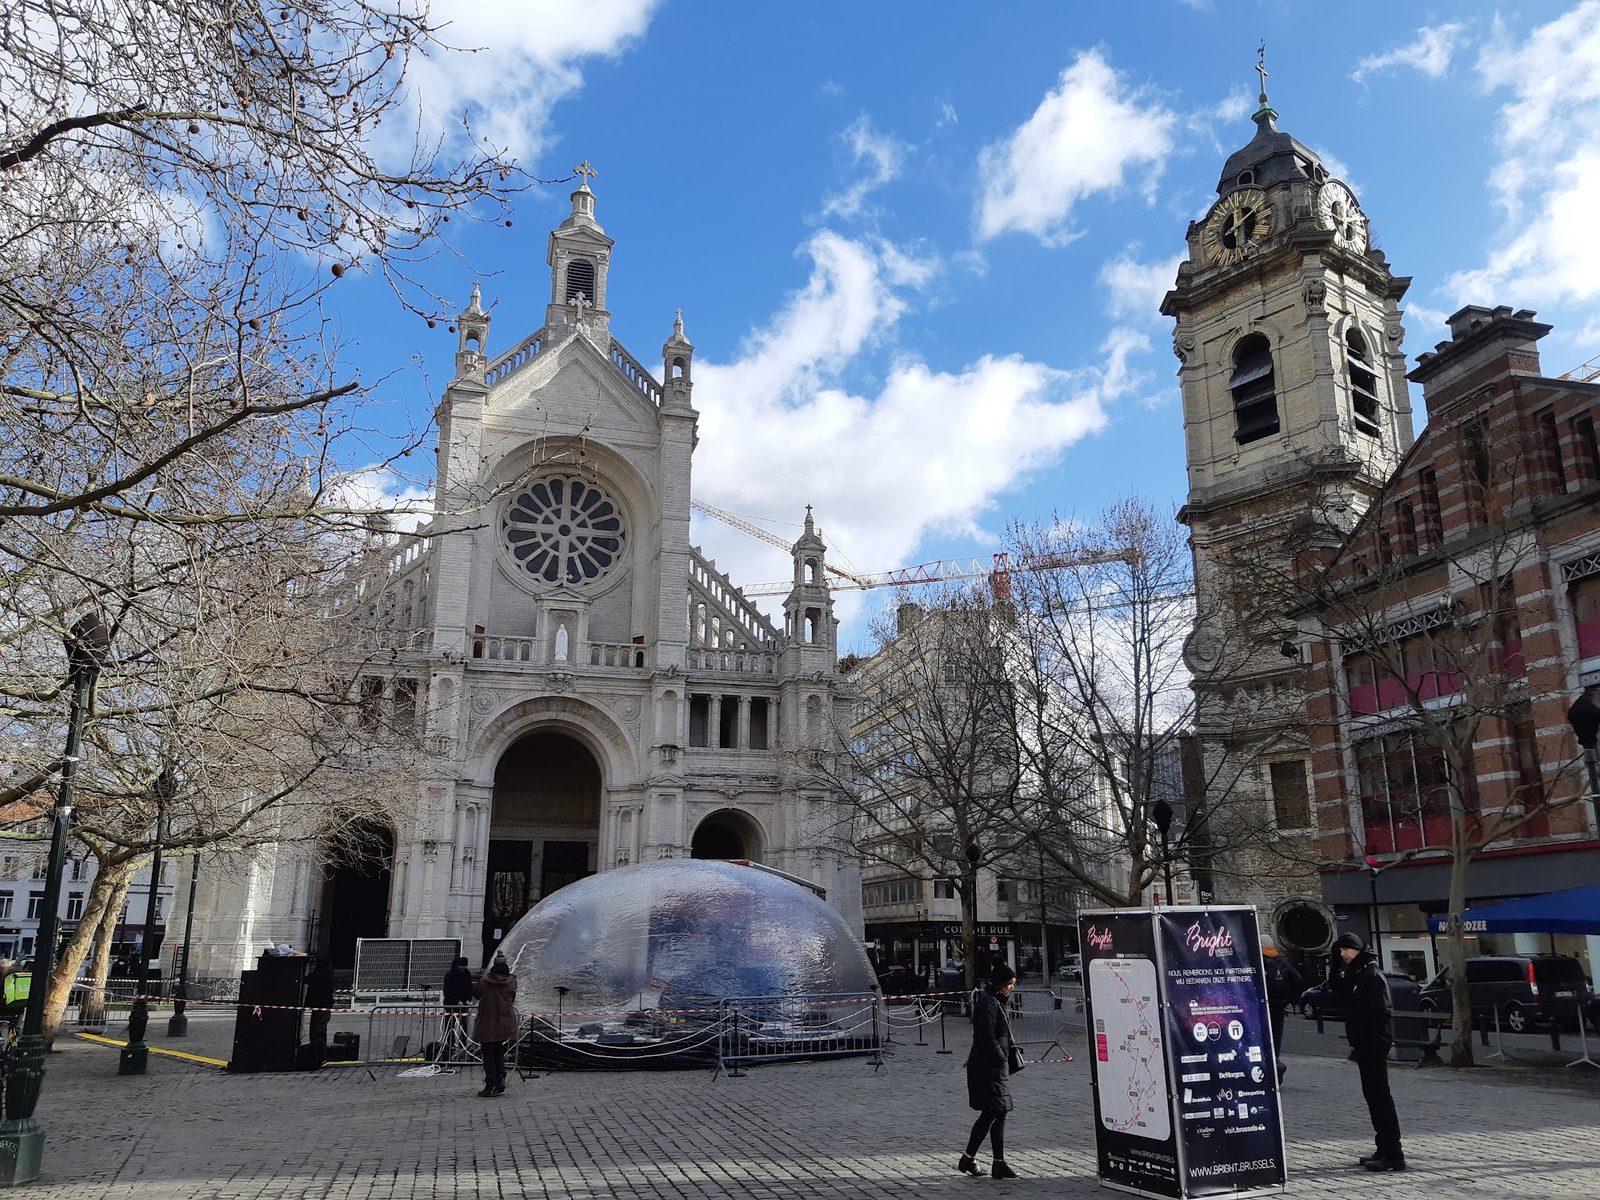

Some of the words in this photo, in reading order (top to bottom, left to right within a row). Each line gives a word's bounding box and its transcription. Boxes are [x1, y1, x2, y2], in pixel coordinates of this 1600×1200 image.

[990, 926, 1010, 934] RUE
[1438, 920, 1487, 932] NDZEE
[1087, 924, 1113, 950] Bright
[1186, 920, 1233, 956] Bright
[1186, 977, 1211, 985] BEDANKEN
[1224, 1125, 1258, 1134] visit.brussels
